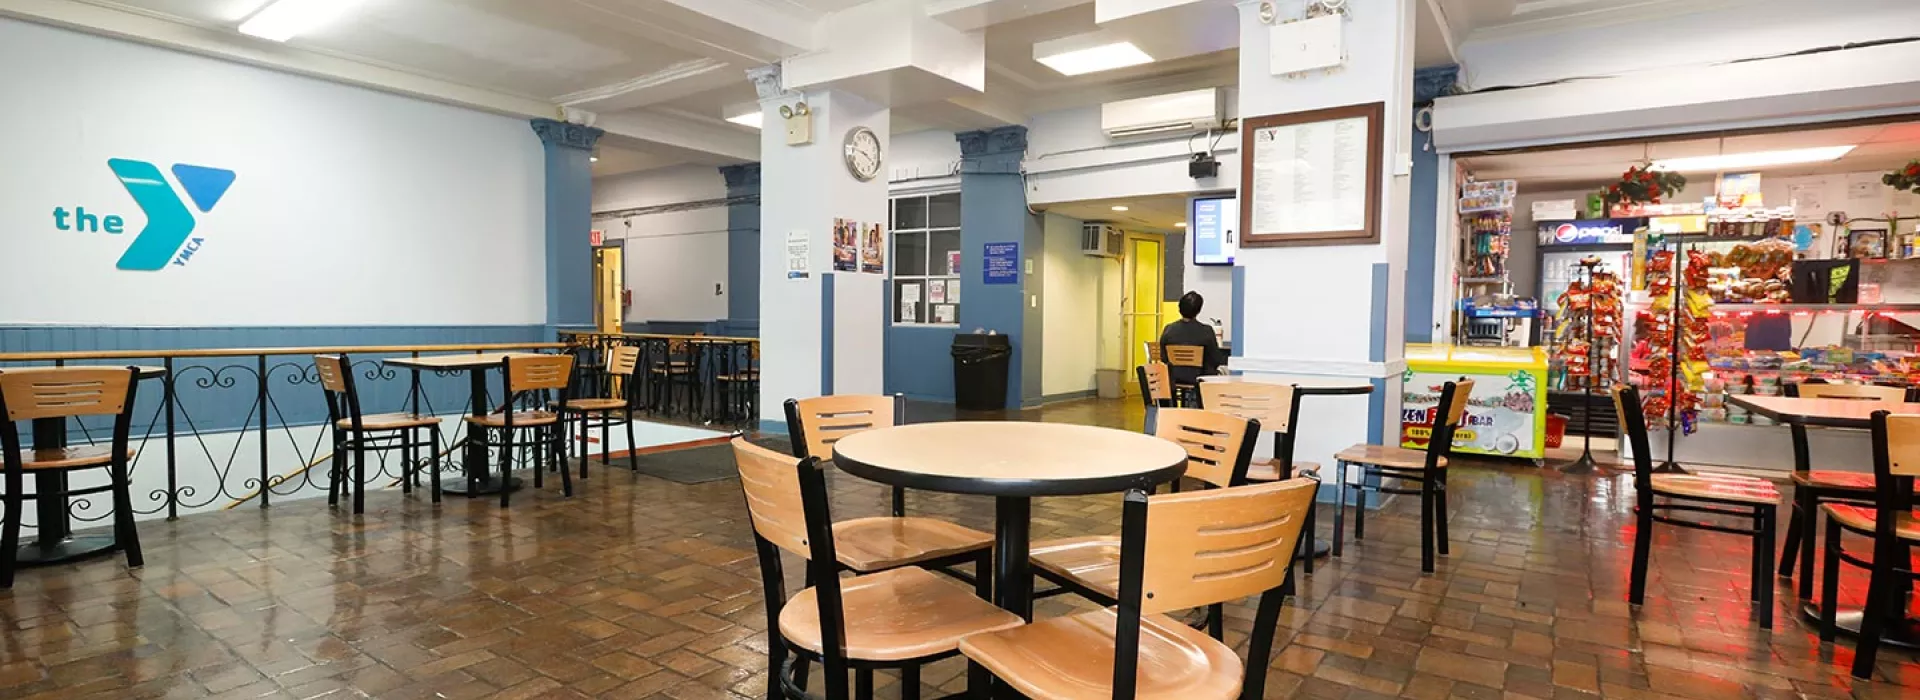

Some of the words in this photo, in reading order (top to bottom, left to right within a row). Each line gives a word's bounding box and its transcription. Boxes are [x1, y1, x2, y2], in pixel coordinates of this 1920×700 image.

[53, 206, 124, 234] the
[1578, 224, 1623, 240] pepsi
[173, 237, 204, 266] YMCA
[1402, 408, 1426, 422] ZEN
[1471, 415, 1493, 427] BAR
